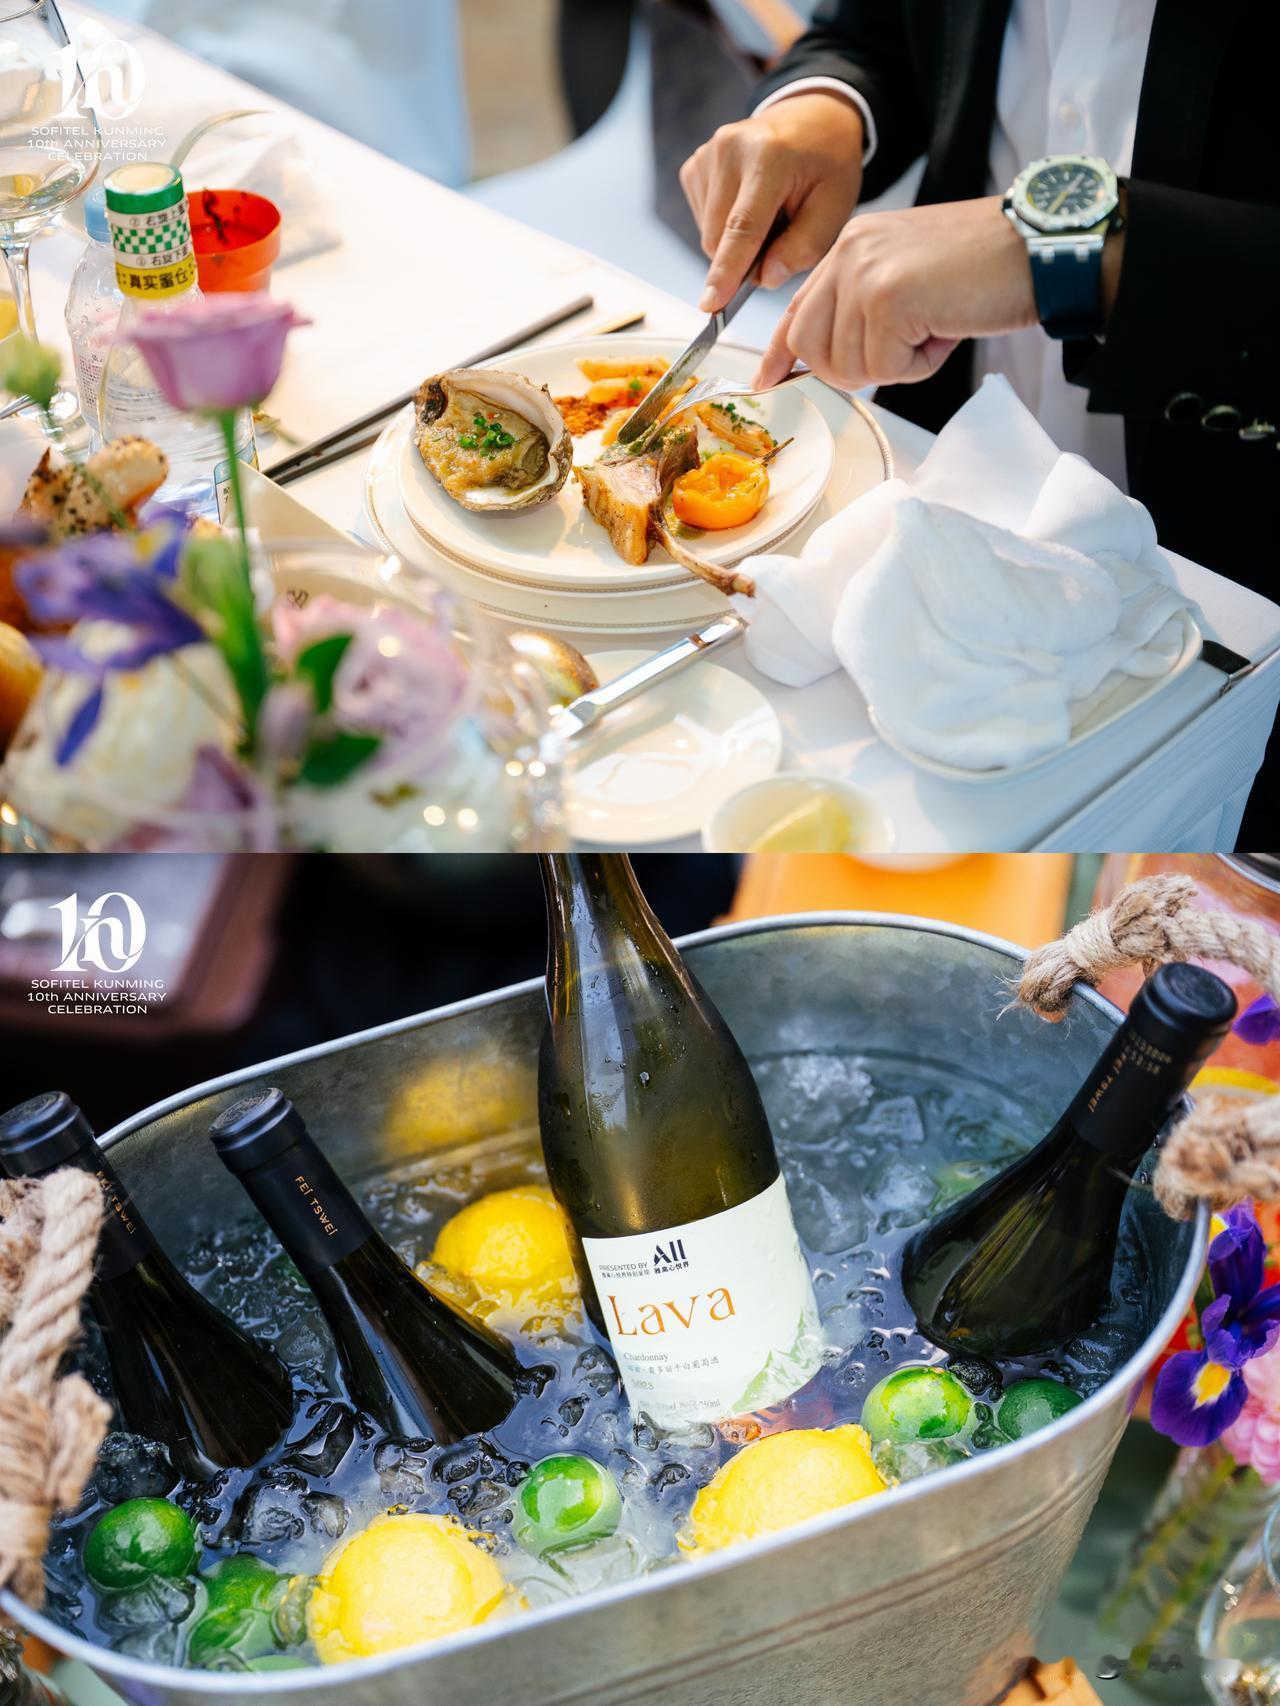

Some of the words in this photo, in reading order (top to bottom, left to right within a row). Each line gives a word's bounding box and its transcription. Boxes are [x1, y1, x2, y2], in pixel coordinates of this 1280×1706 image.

[599, 1263, 636, 1272] PRESENTED
[638, 1261, 648, 1269] BY
[608, 1287, 736, 1336] Lava
[623, 1351, 669, 1363] Chardonnay
